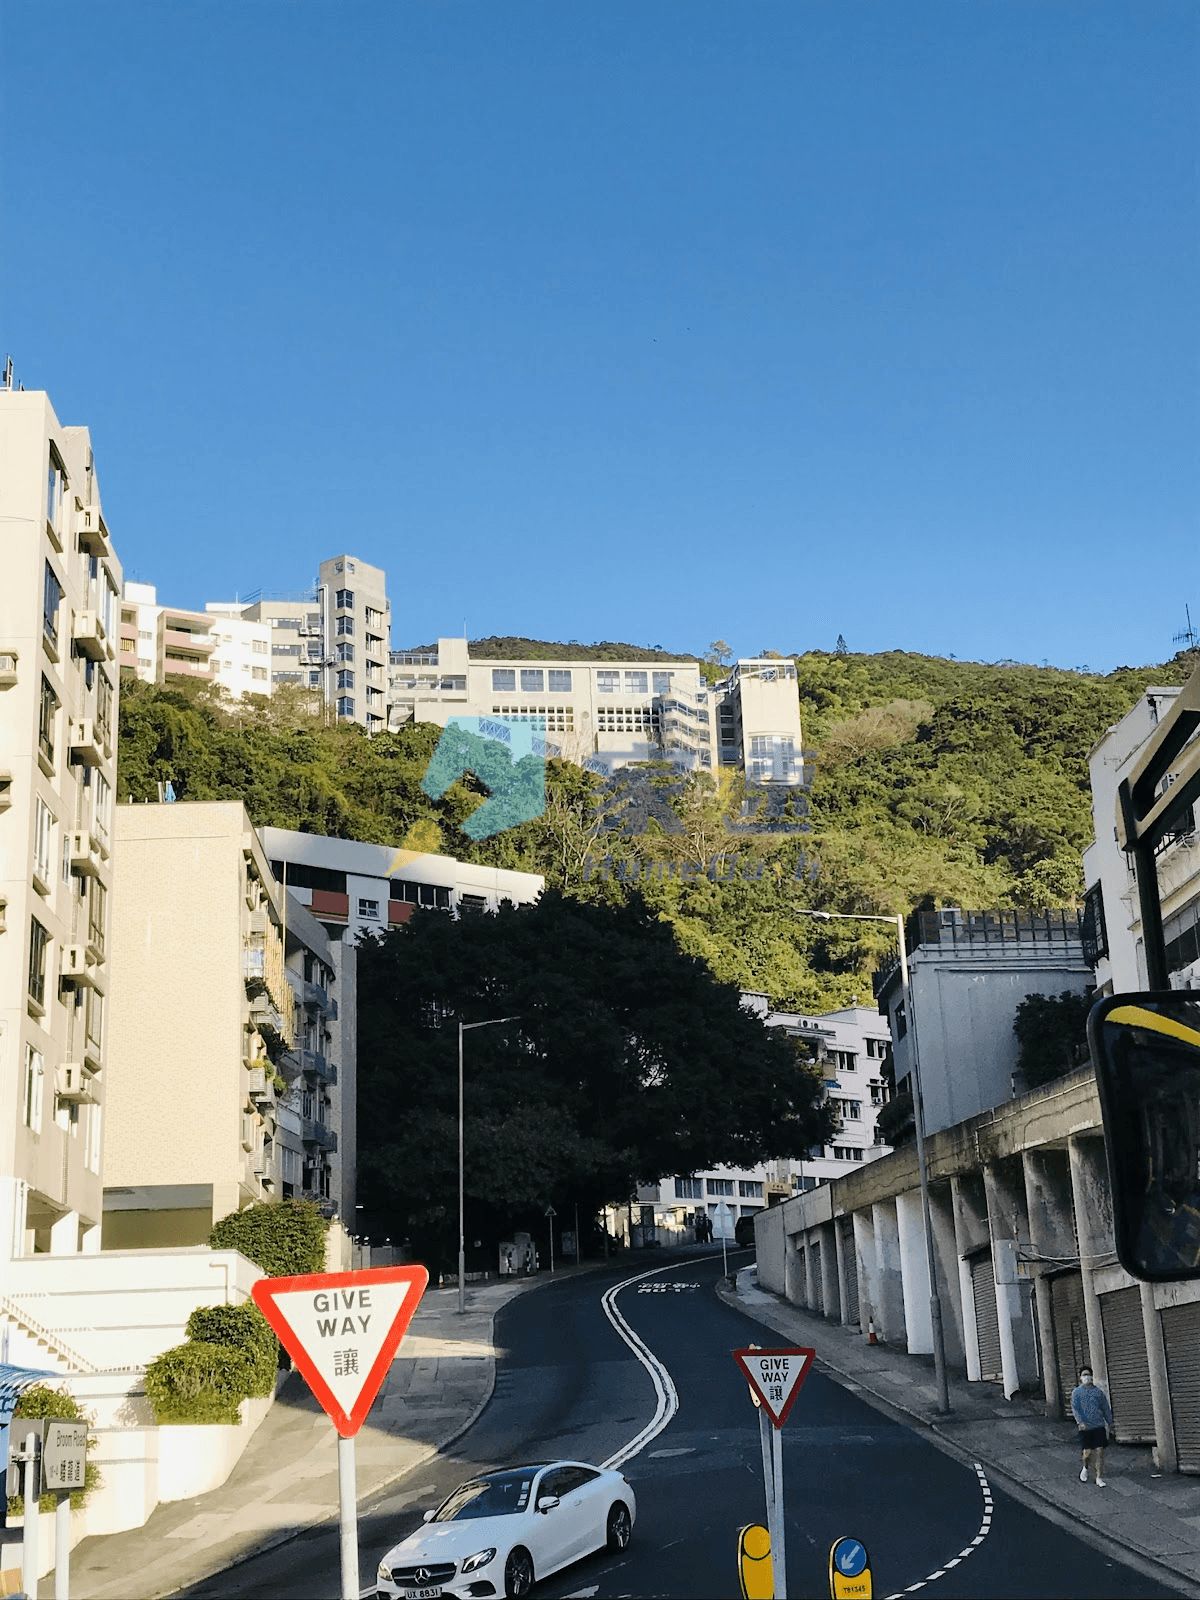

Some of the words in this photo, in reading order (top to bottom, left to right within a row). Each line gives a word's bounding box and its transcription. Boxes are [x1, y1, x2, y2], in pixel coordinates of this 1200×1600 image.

[313, 1289, 372, 1313] GIVE
[316, 1314, 371, 1338] WAY
[333, 1348, 359, 1377] 讓
[760, 1358, 789, 1370] GIVE
[761, 1371, 789, 1383] WAY
[769, 1385, 783, 1401] 讓
[73, 1430, 86, 1446] Road
[419, 1588, 438, 1598] 8831
